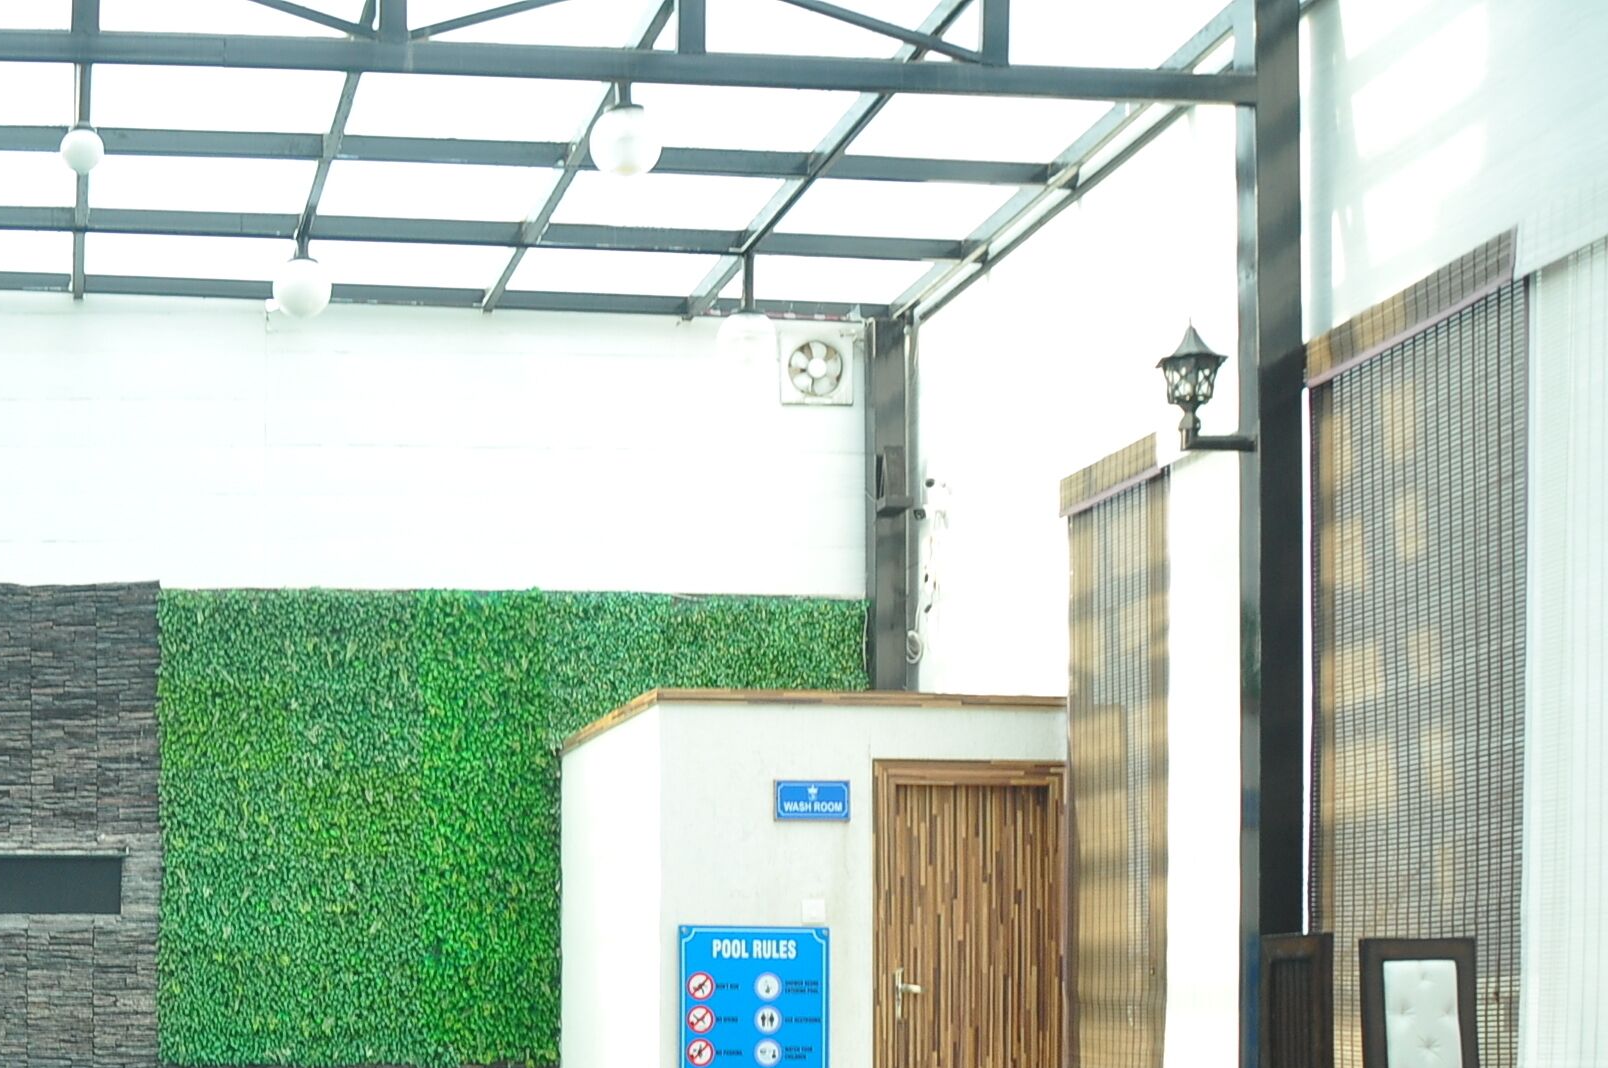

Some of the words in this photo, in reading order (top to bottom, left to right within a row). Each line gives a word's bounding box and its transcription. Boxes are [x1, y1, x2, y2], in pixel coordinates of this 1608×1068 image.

[783, 801, 811, 812] WASH
[813, 801, 843, 812] ROOM
[712, 938, 749, 959] POOL
[753, 938, 797, 960] RULES
